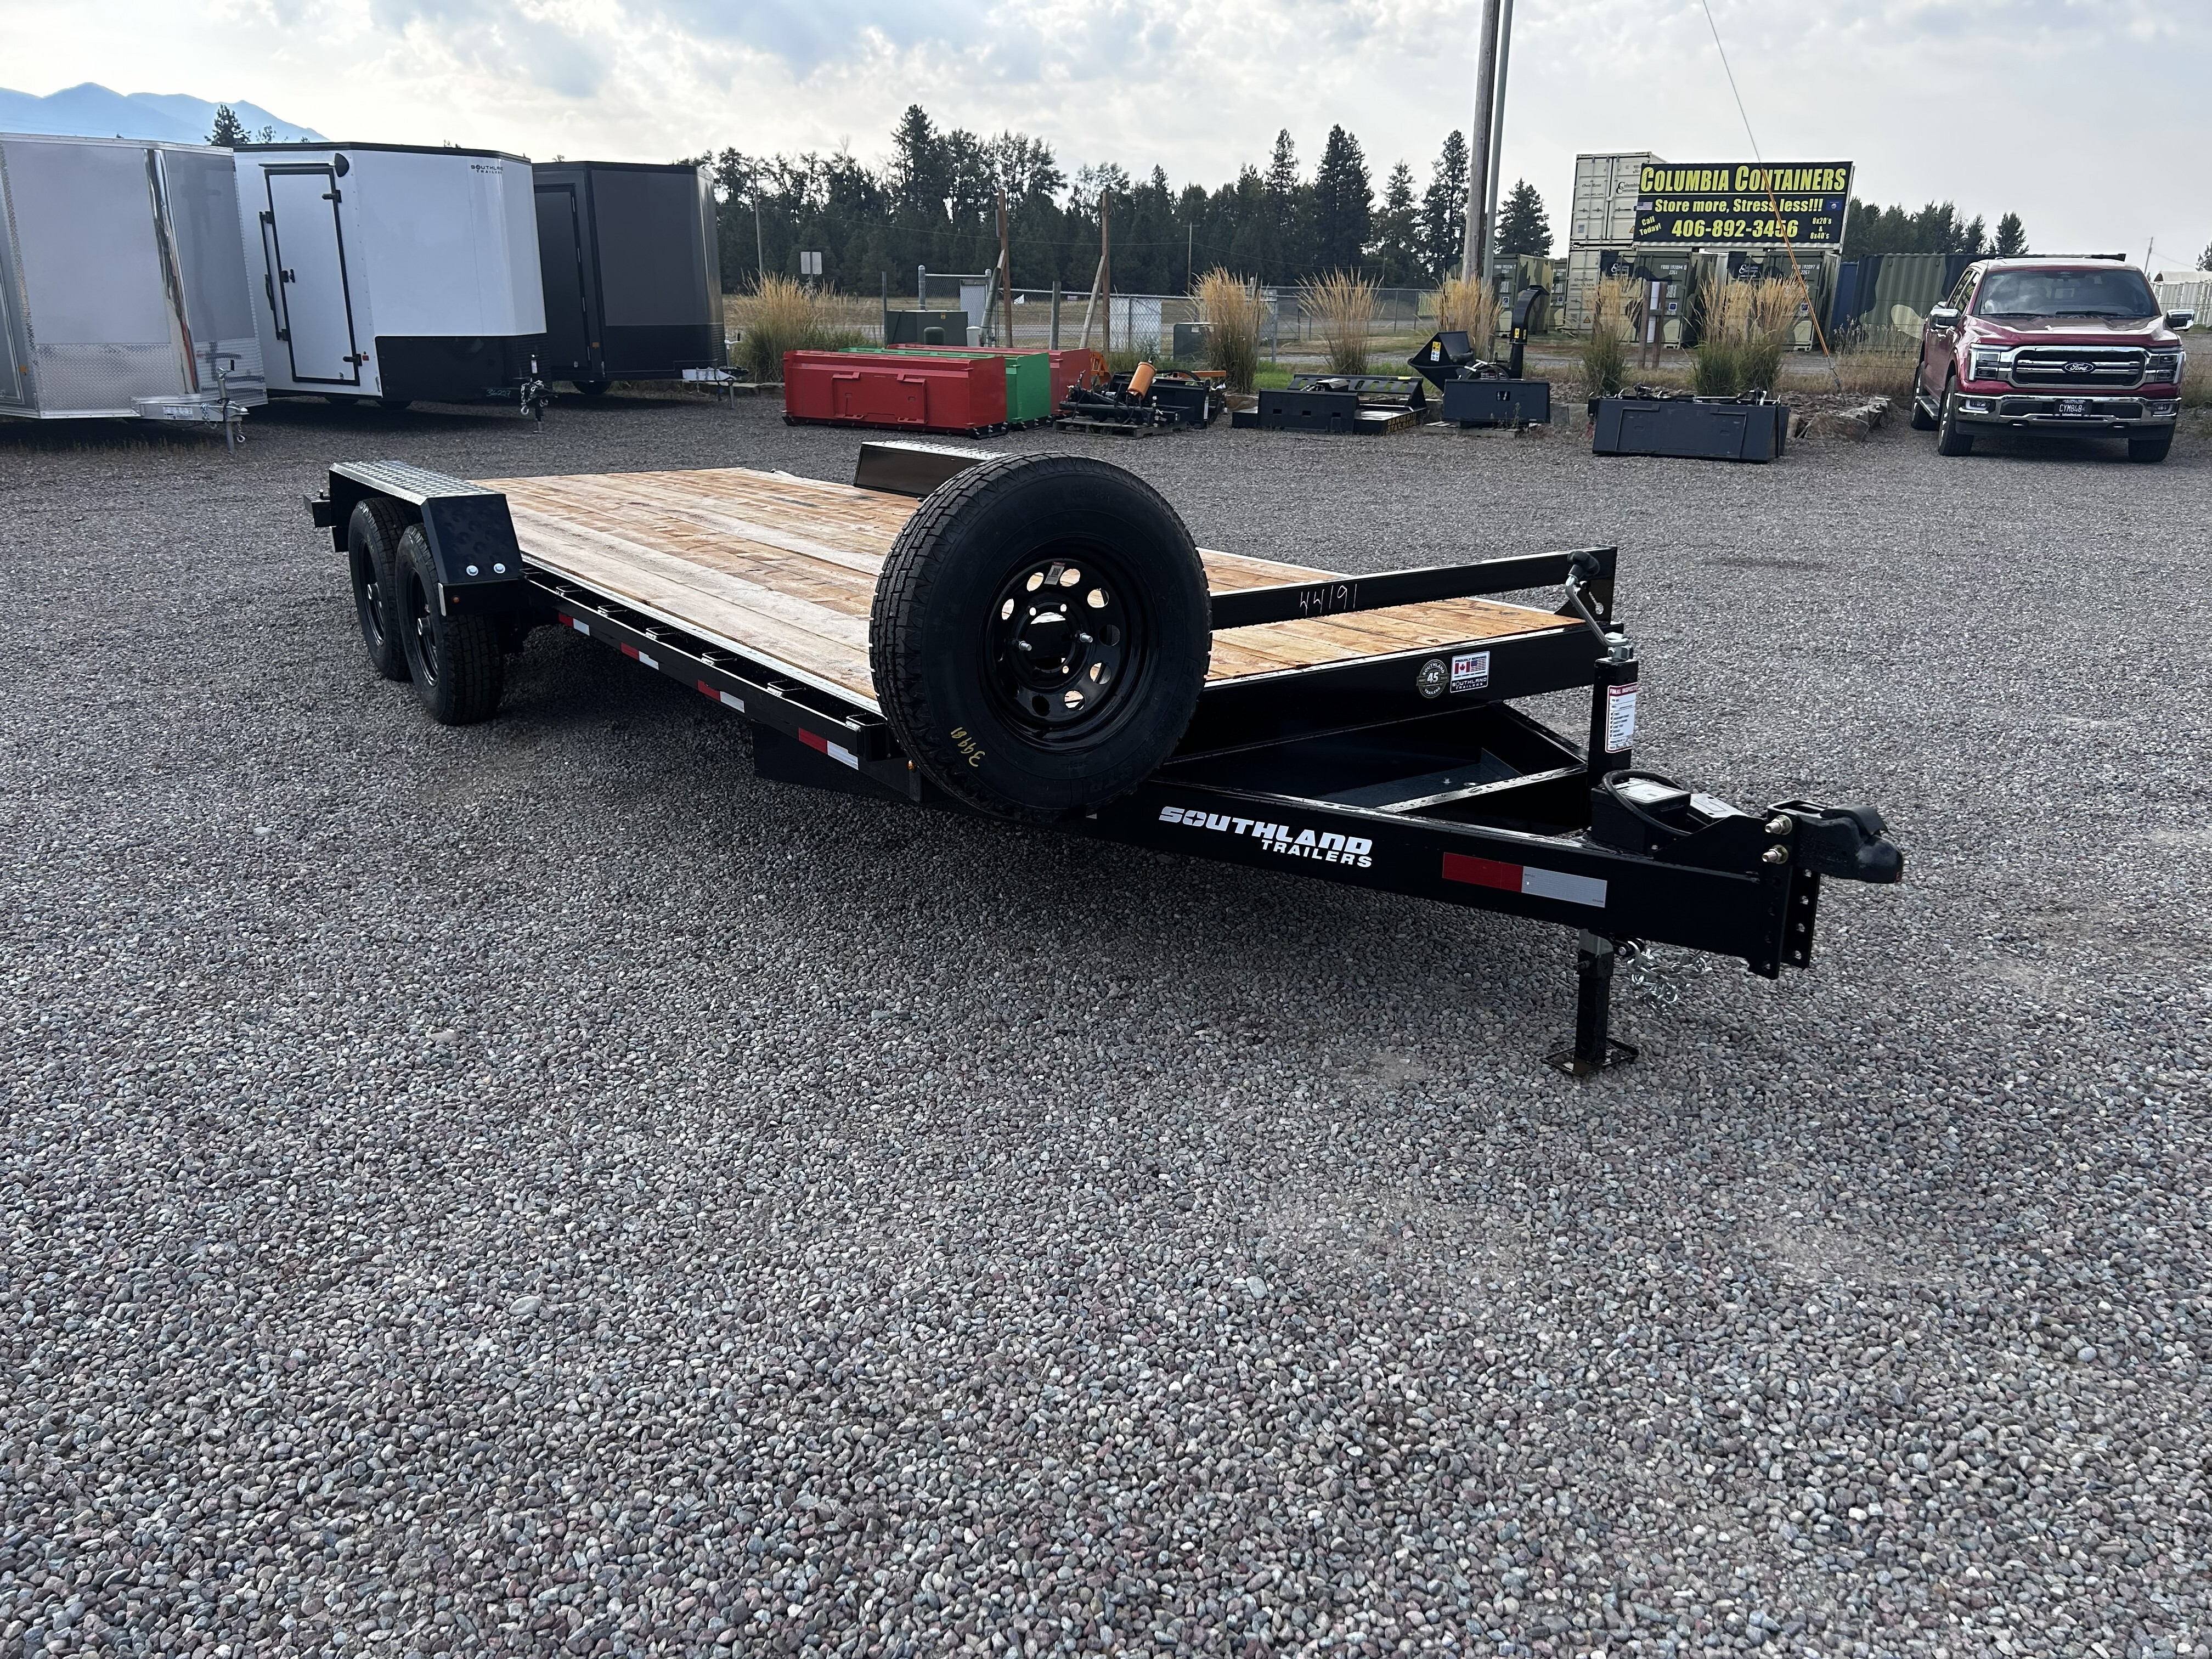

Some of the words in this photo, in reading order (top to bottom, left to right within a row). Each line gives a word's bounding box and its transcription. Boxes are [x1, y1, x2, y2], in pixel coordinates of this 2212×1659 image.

[1641, 167, 1729, 192] COLUMBIA
[1735, 166, 1846, 191] CONTAINERS
[1655, 199, 1690, 212] Store
[1692, 200, 1730, 213] more,
[1733, 199, 1776, 212] Stress
[1779, 198, 1824, 212] less!!!
[1641, 216, 1656, 226] Call
[1672, 219, 1799, 238] 406-892-3456
[1639, 222, 1662, 236] Today!
[1300, 583, 1357, 616] 44191
[1423, 662, 1444, 675] SOUTHLAND
[1427, 672, 1438, 683] 45
[1452, 678, 1487, 687] SOUTHLAND
[1158, 806, 1373, 855] SOUTHLAND
[1262, 839, 1372, 868] TRAILERS
